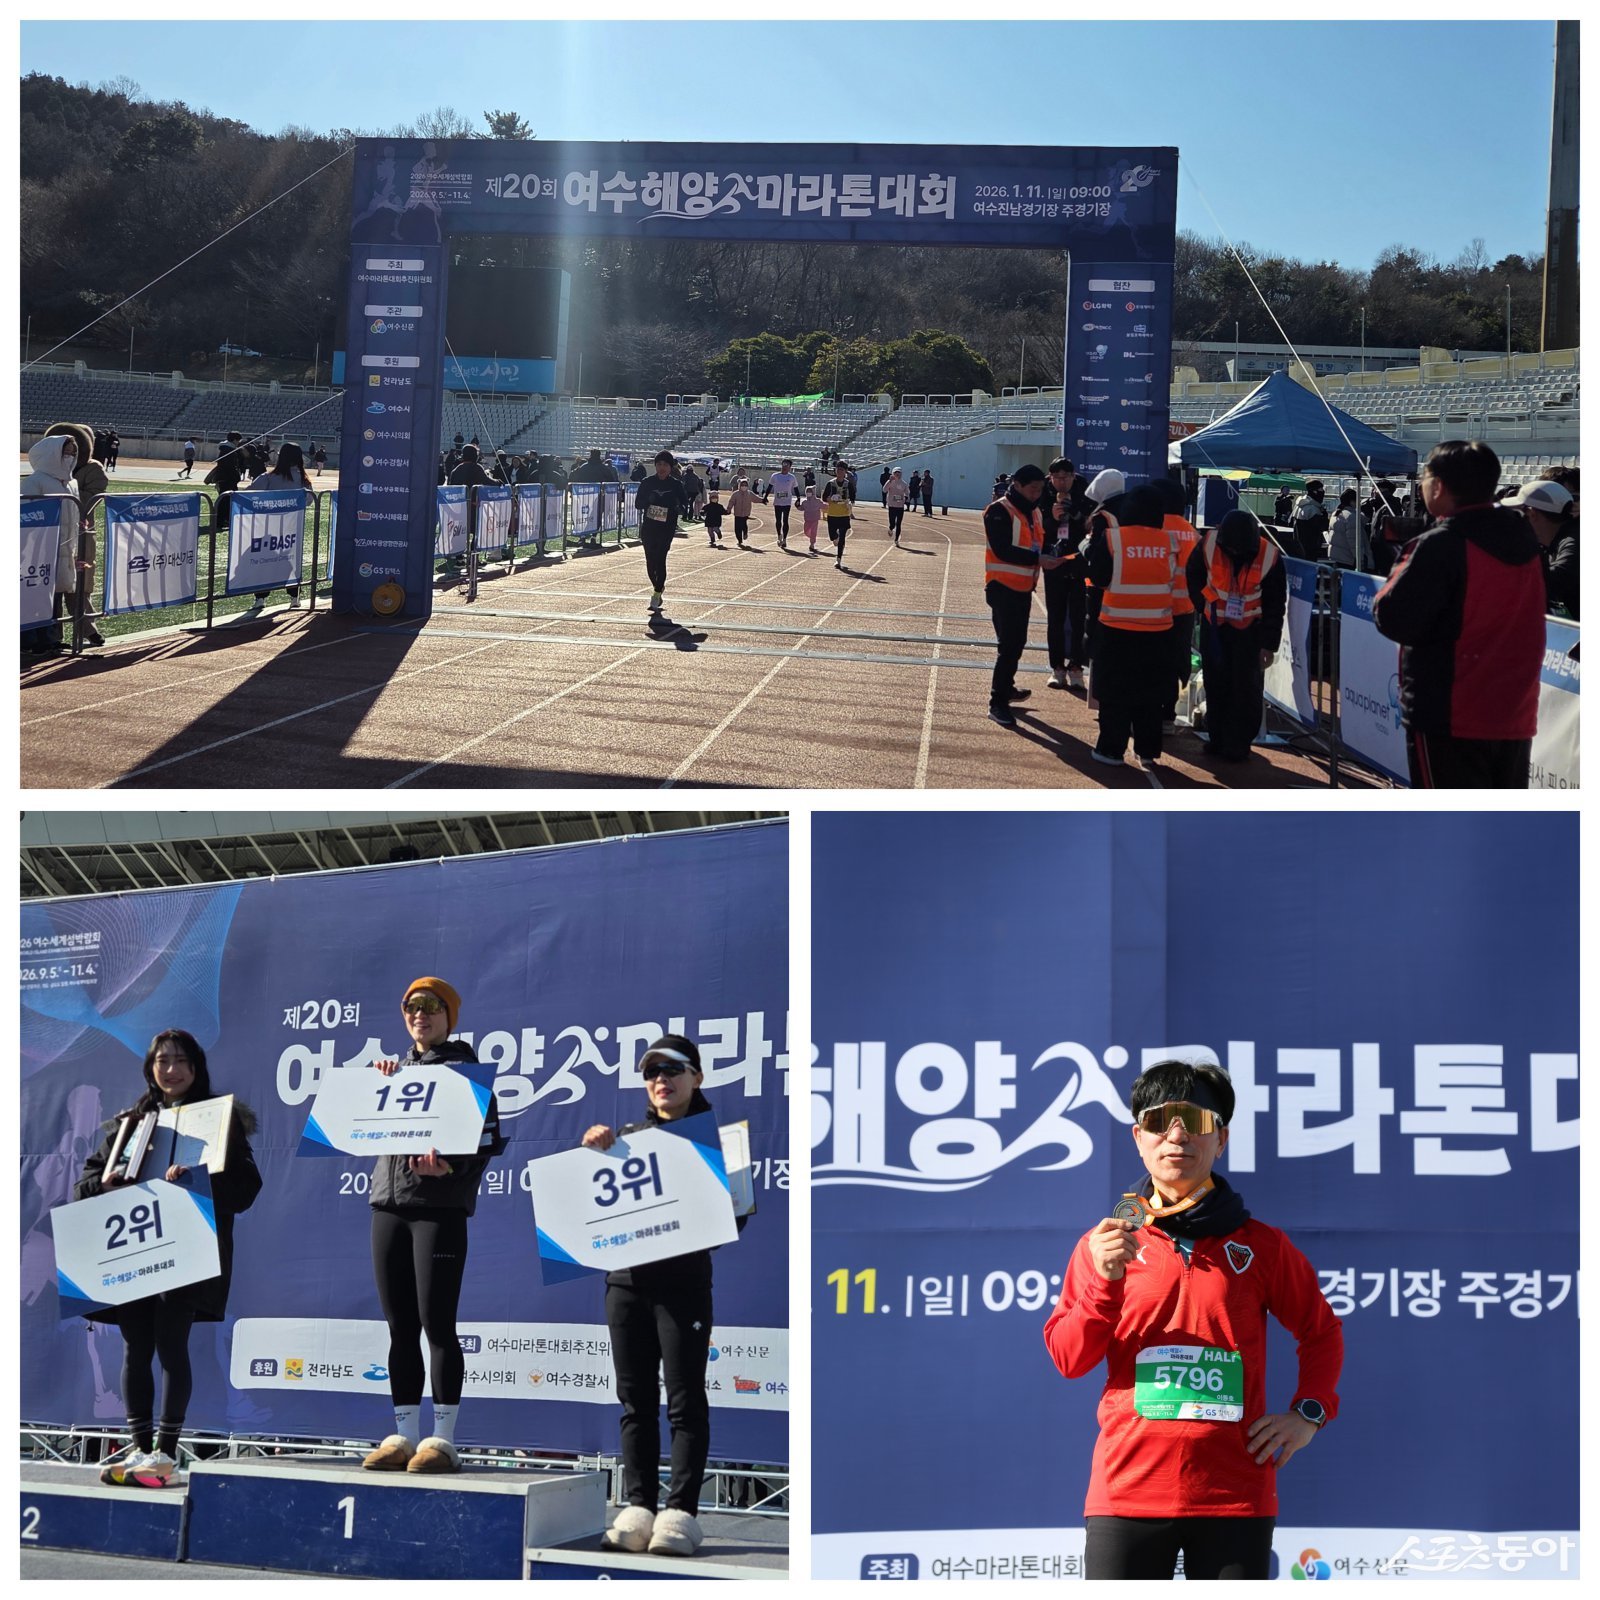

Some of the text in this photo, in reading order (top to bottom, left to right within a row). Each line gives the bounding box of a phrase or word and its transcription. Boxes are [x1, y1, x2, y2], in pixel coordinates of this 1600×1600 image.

[485, 170, 957, 219] 제20회 여수해양 마라톤대회
[975, 185, 1010, 198] 2026.
[1012, 184, 1023, 198] 1.
[1027, 184, 1044, 198] 11.
[1069, 185, 1111, 198] 09:00
[973, 202, 1111, 218] 여수진남경기장 주경기장
[387, 260, 403, 269] 주최
[1113, 281, 1131, 291] 협찬
[387, 306, 402, 315] 주관
[387, 323, 415, 331] 여수신문
[384, 357, 399, 366] 후원
[383, 377, 412, 386] 전라남도
[387, 405, 411, 413] 여수시
[376, 431, 411, 440] 여수시의회
[375, 458, 409, 467] 여수경찰서
[371, 512, 409, 521] 여수시체육회
[270, 534, 296, 551] BASF
[1176, 531, 1195, 541] TAFF
[152, 550, 194, 570] (주)대신기공
[1126, 546, 1166, 559] STAFF
[20, 563, 51, 587] 은행
[373, 567, 384, 575] GS
[1356, 593, 1374, 612] 여수
[1344, 686, 1391, 722] aquaplanet
[33, 931, 101, 948] 여수세계섬박람회
[282, 999, 360, 1030] 제20회
[375, 1081, 437, 1112] 1위
[592, 1152, 663, 1207] 3위
[105, 1200, 163, 1251] 2위
[635, 1220, 680, 1239] 마라톤대회
[138, 1259, 175, 1277] 마라톤대회
[826, 1268, 891, 1314] 11.
[1318, 1268, 1446, 1318] 경기장
[487, 1338, 611, 1357] 여수마라톤대회추진위
[721, 1344, 770, 1358] 여수신문
[253, 1361, 273, 1376] 후원
[307, 1362, 354, 1378] 전라남도
[546, 1371, 610, 1389] 여수경찰서
[765, 1380, 789, 1394] 여수
[1153, 1365, 1224, 1392] 5796
[1205, 1408, 1217, 1417] GS
[21, 1506, 40, 1540] 2
[336, 1496, 355, 1539] 1
[867, 1558, 910, 1579] 주최
[1333, 1556, 1409, 1577] 여수신문
